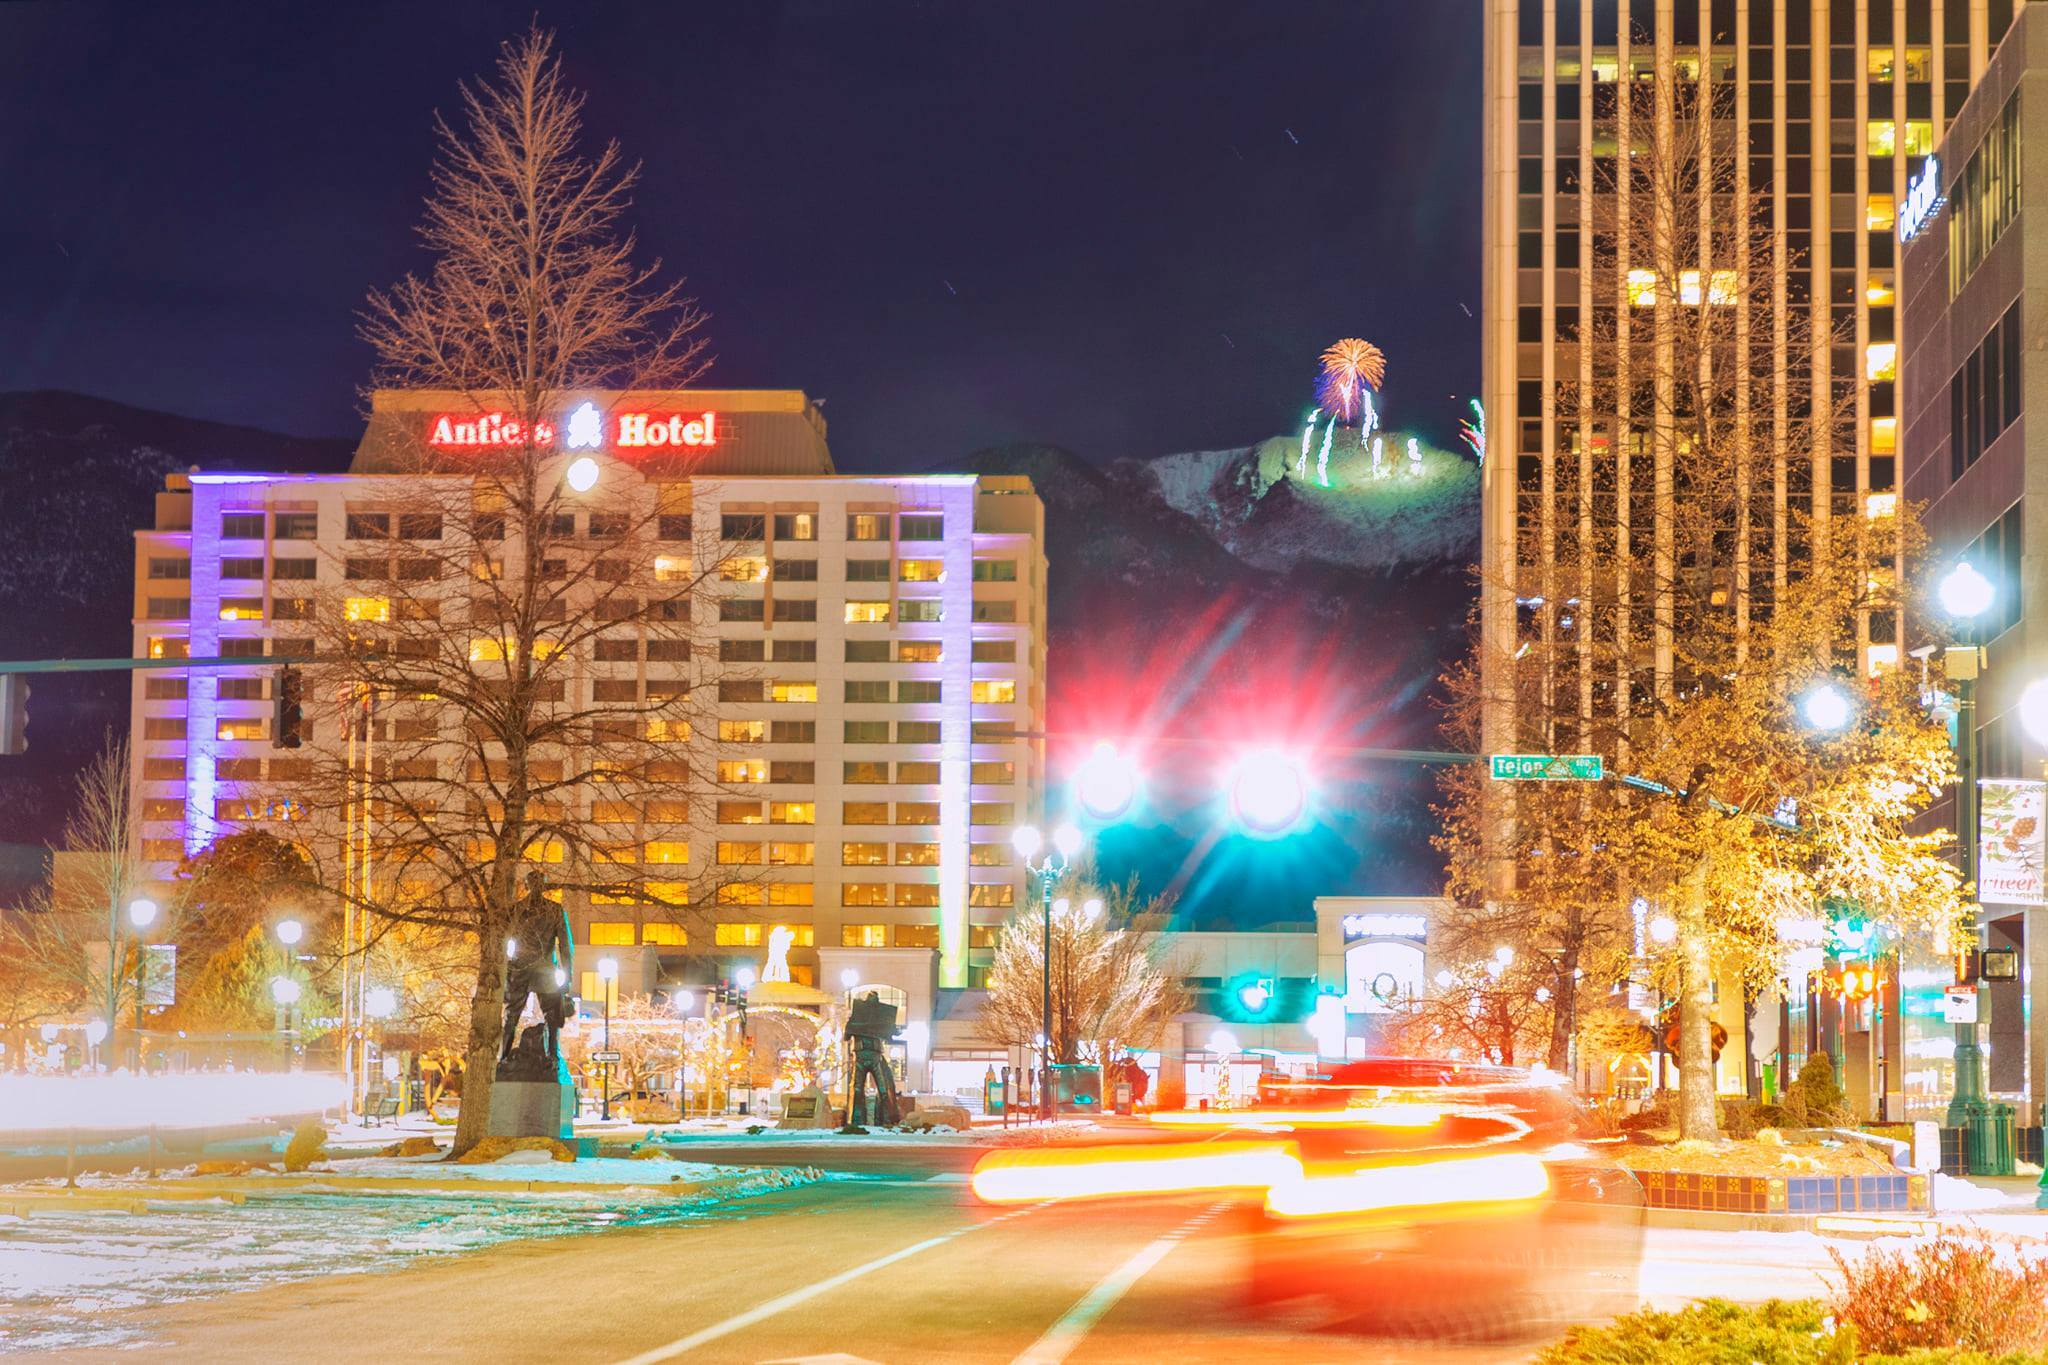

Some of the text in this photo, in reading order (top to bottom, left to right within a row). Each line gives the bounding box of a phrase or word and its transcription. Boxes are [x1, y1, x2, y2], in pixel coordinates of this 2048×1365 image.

[430, 412, 716, 446] Antles Hotel
[1497, 759, 1543, 777] Tejon
